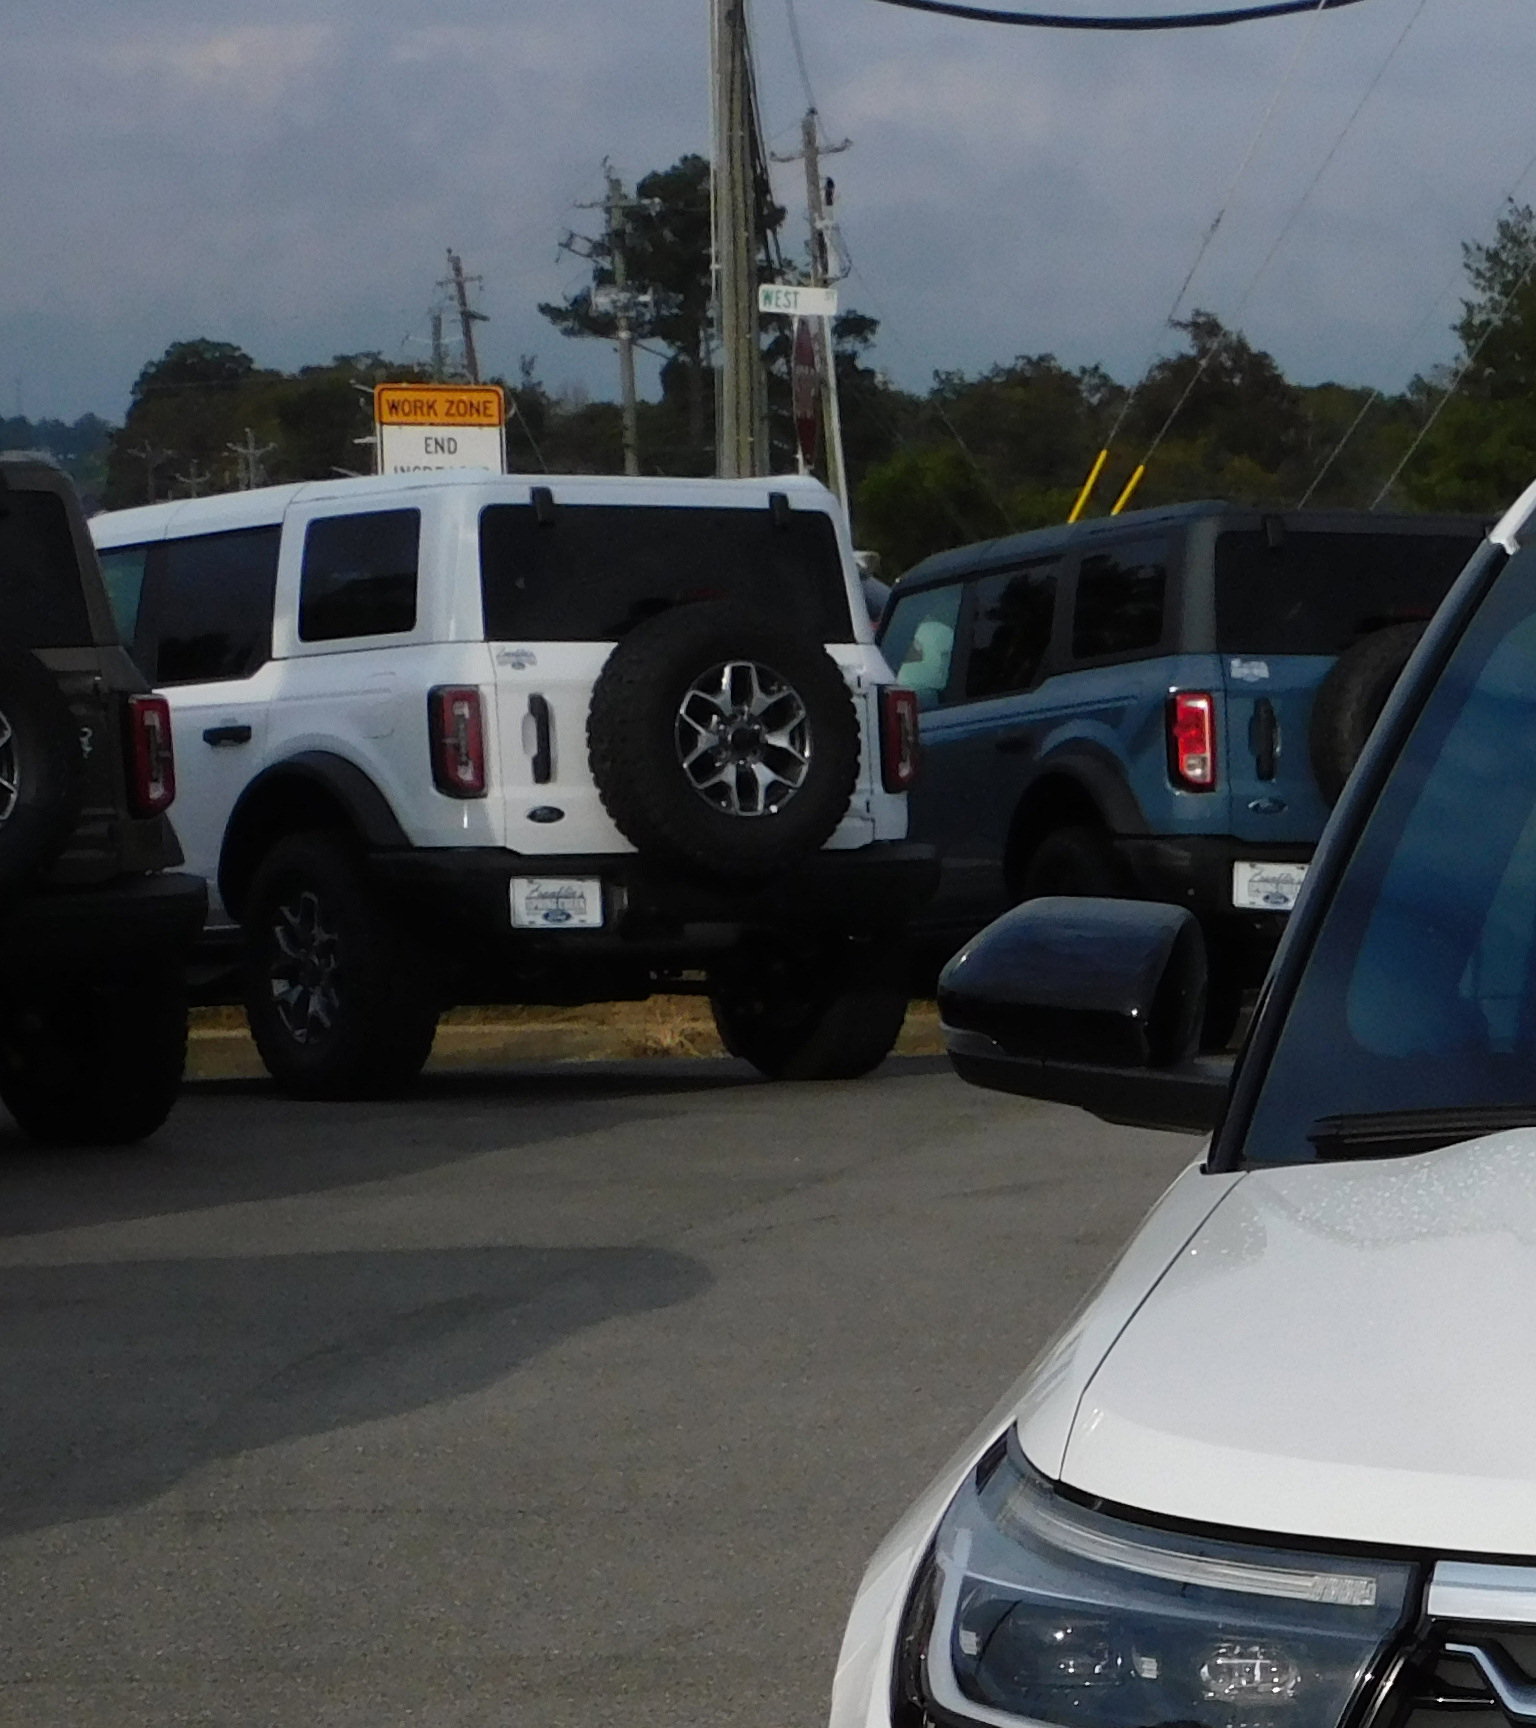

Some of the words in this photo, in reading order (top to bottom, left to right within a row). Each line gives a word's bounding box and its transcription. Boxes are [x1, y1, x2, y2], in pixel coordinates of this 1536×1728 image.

[762, 289, 800, 309] WEST
[387, 398, 438, 417] WORK
[444, 399, 495, 418] ZONE
[424, 436, 458, 455] END
